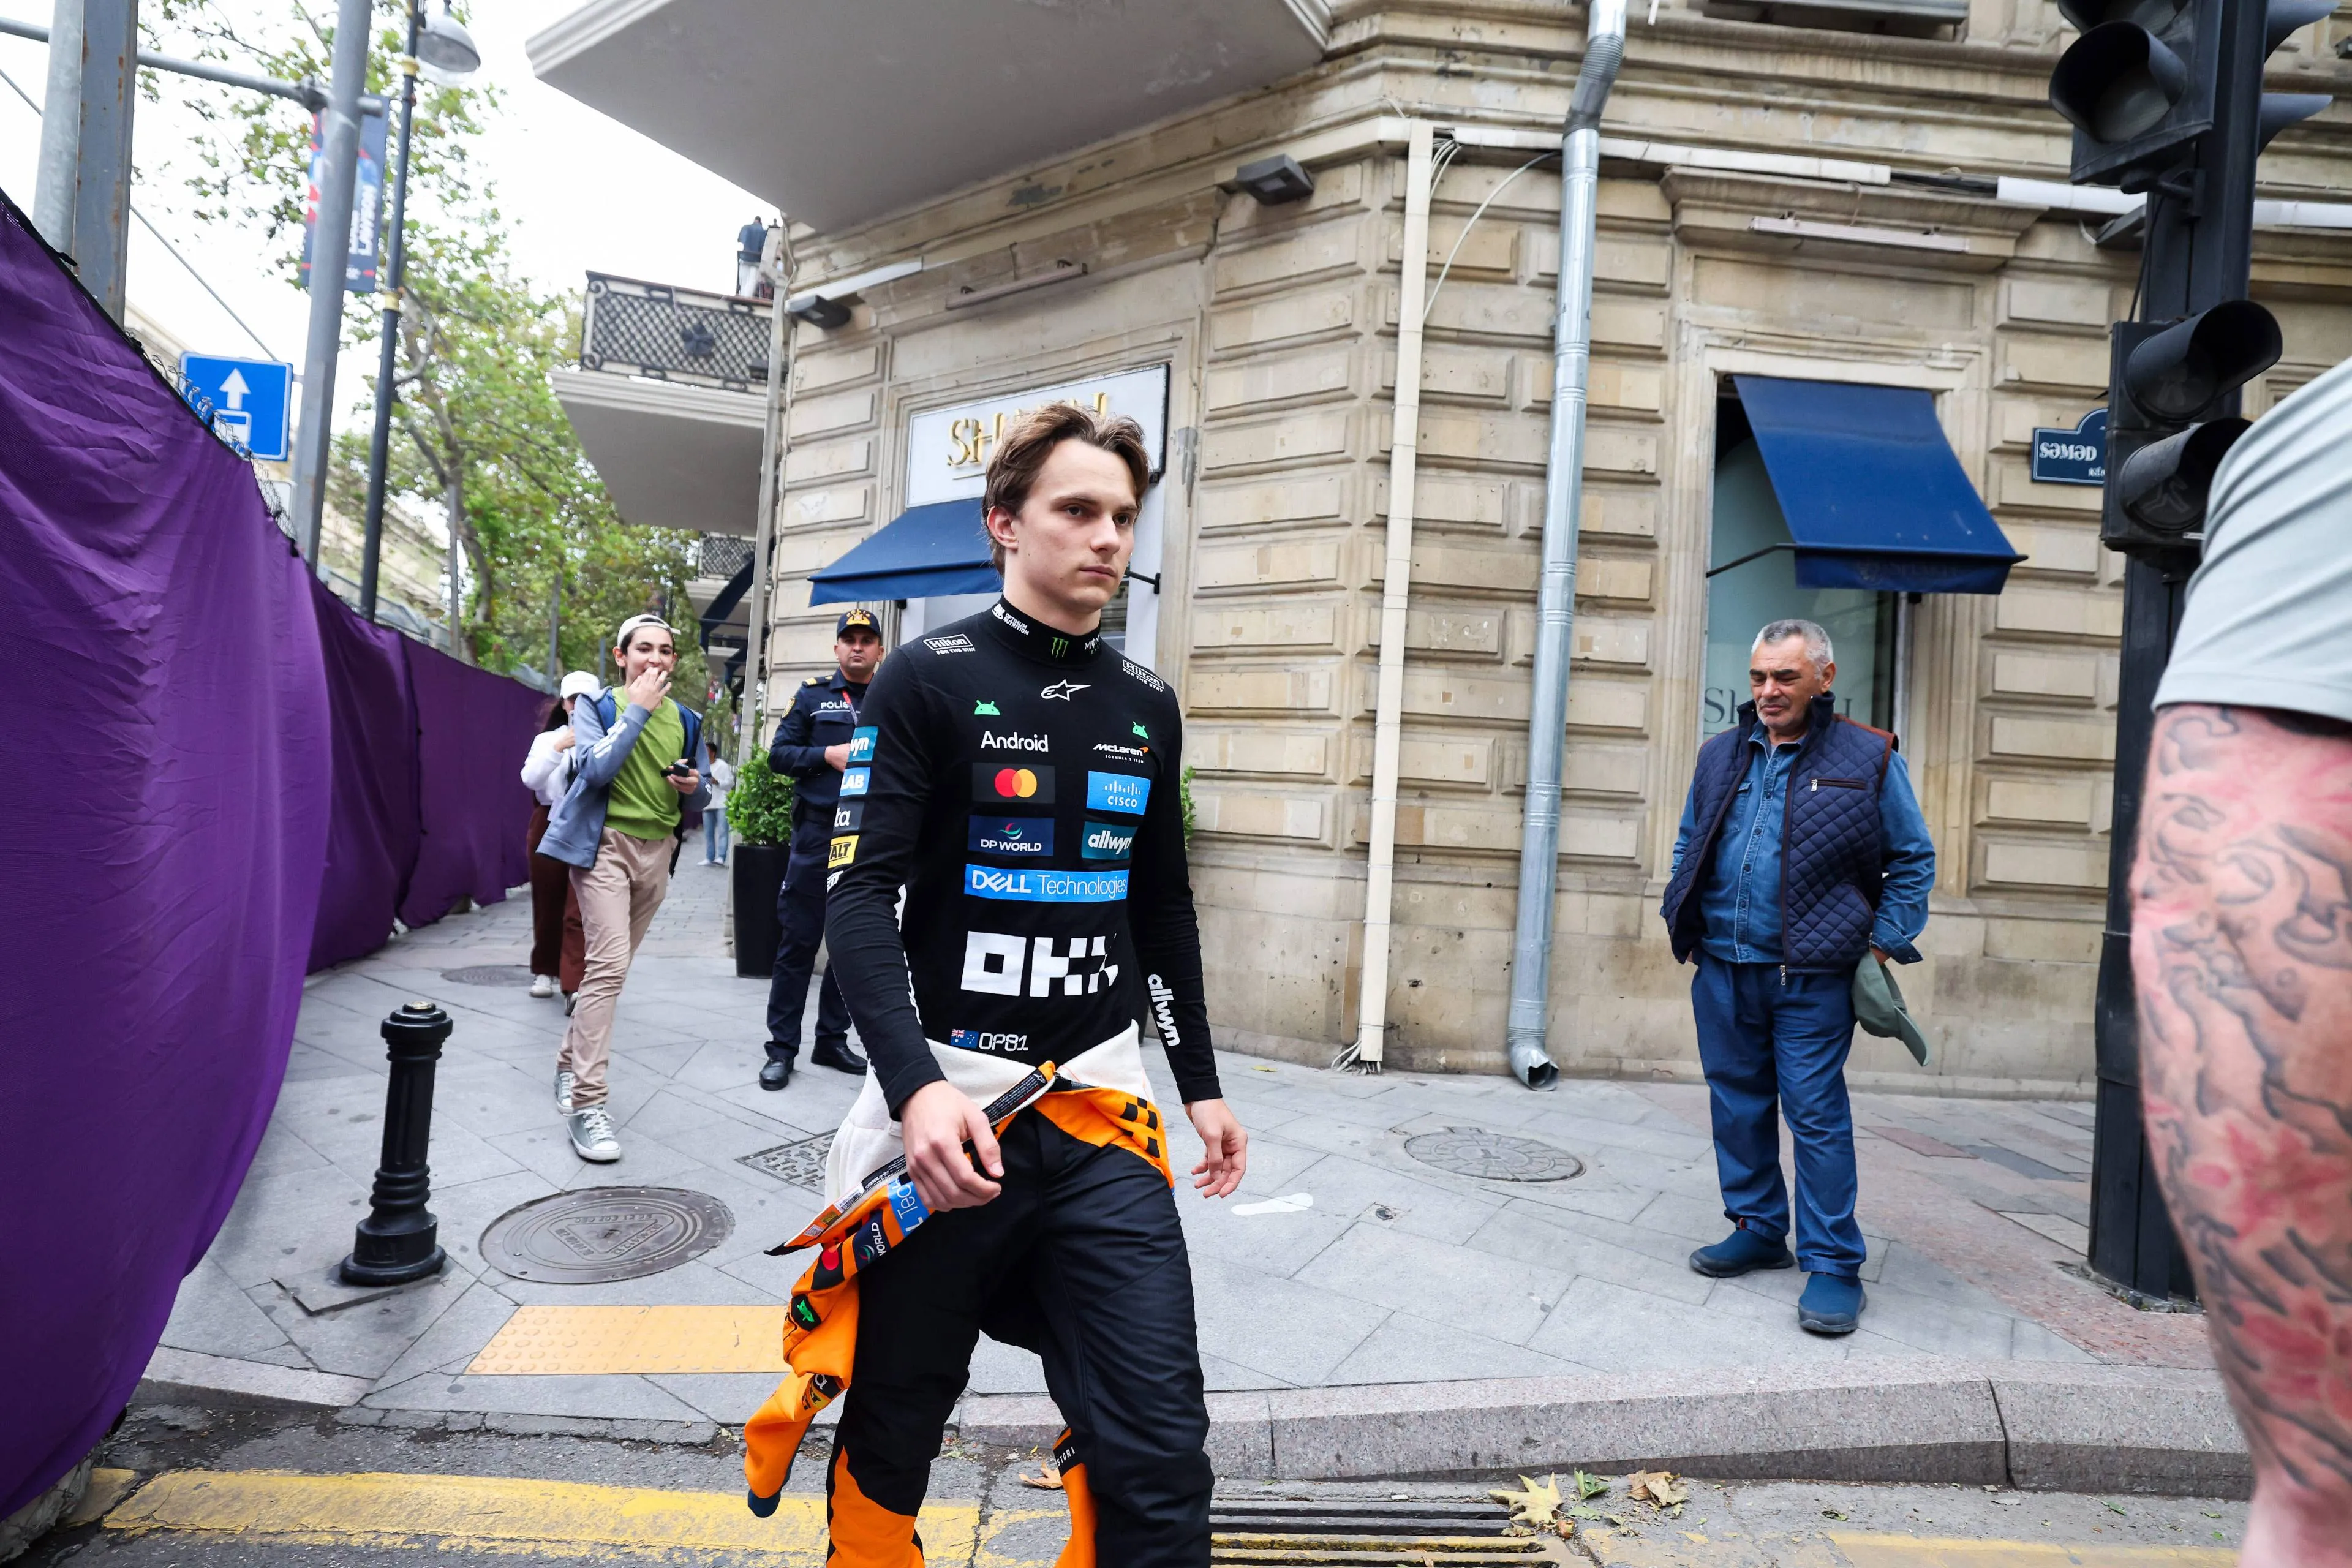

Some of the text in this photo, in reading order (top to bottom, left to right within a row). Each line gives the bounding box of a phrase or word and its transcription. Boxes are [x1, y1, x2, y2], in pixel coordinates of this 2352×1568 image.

[1003, 617, 1029, 636] NUTRITION
[1005, 613, 1028, 630] OPTIMUM
[929, 638, 968, 648] Hilton
[1123, 668, 1163, 693] FOR THE STAY
[1126, 662, 1161, 686] Hilton
[850, 737, 869, 757] wyn
[980, 730, 1049, 752] Android
[1093, 743, 1144, 756] McLaren
[829, 843, 851, 860] ALT
[980, 839, 1042, 852] DP WORLD
[1088, 829, 1133, 854] allwyn
[971, 870, 1126, 899] DELL Technologies
[1147, 973, 1181, 1047] allwyn
[978, 1032, 1029, 1052] OP81
